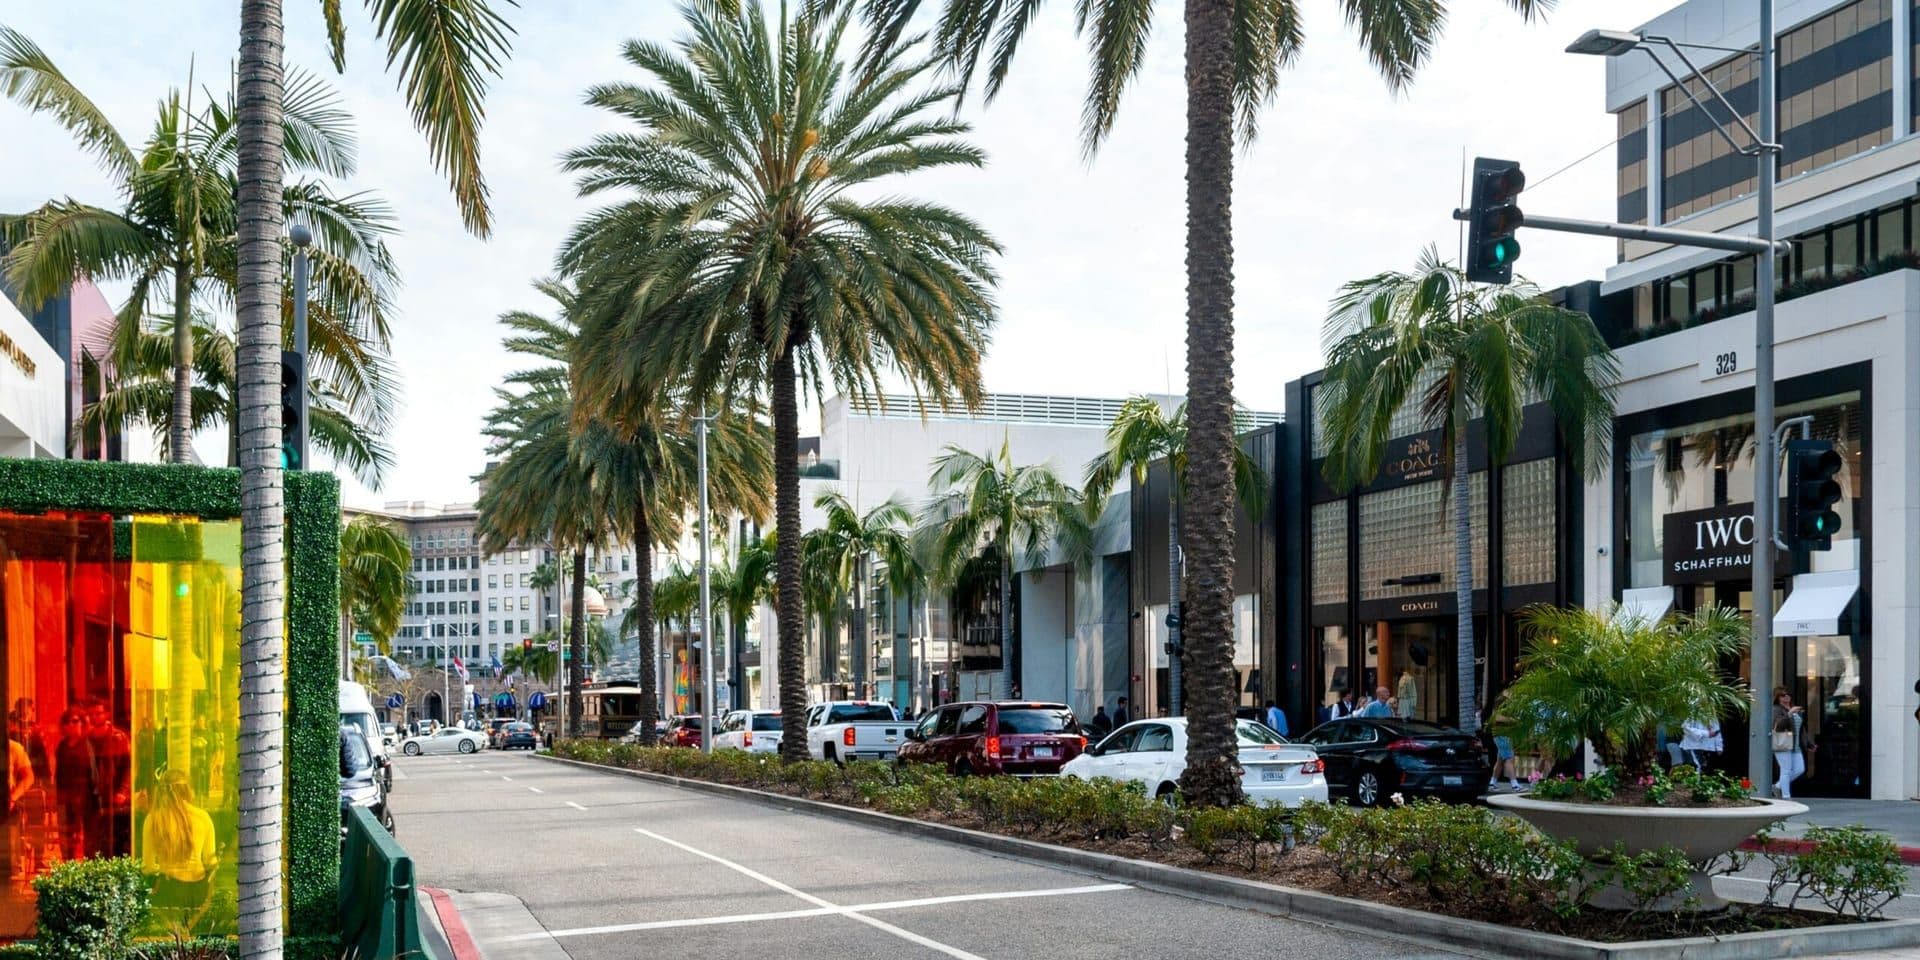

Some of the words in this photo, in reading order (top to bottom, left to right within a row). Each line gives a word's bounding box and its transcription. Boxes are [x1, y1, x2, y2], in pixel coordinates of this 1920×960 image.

[1716, 351, 1737, 375] 329
[1385, 453, 1448, 475] COAC
[1695, 514, 1755, 550] IWC
[1673, 554, 1752, 572] SCHAFFHAU
[1401, 601, 1438, 611] COACH
